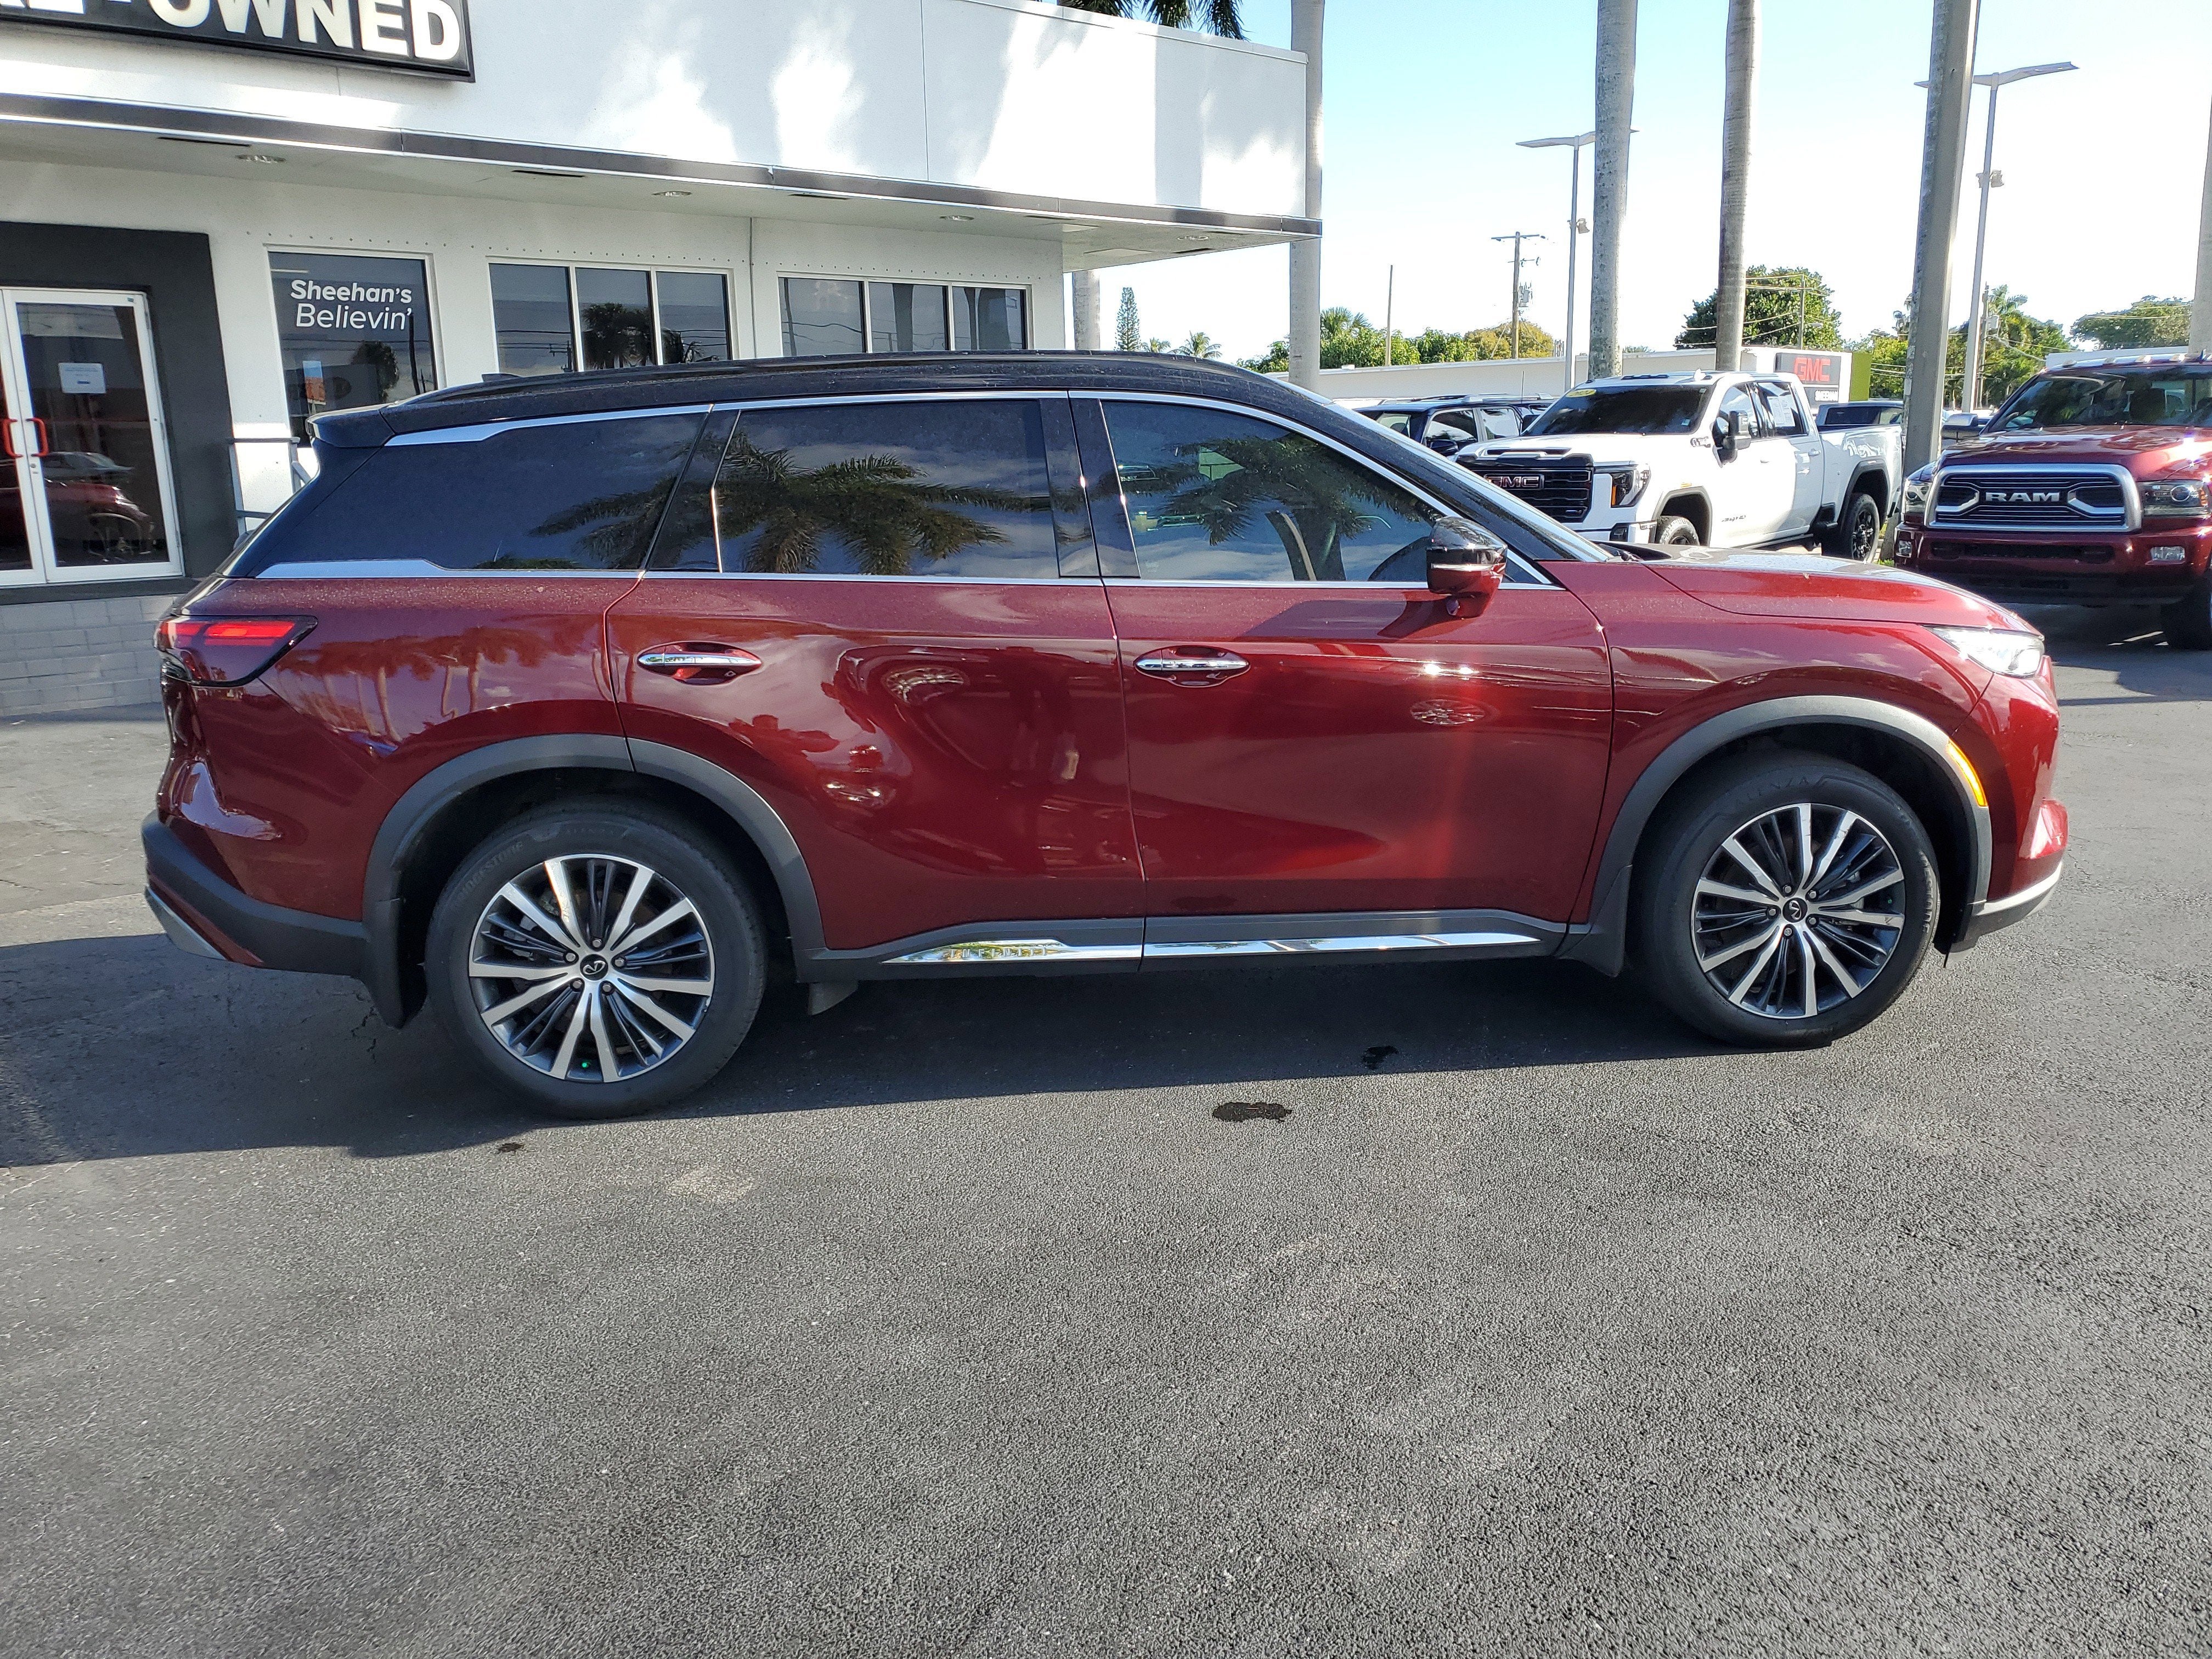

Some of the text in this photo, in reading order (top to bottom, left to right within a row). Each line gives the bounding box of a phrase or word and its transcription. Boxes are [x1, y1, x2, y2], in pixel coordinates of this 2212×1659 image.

[290, 279, 412, 303] Sheehan's
[296, 303, 412, 330] Believin'
[1794, 357, 1831, 381] GMC
[1487, 476, 1539, 487] GMC
[1985, 492, 2059, 501] RAM
